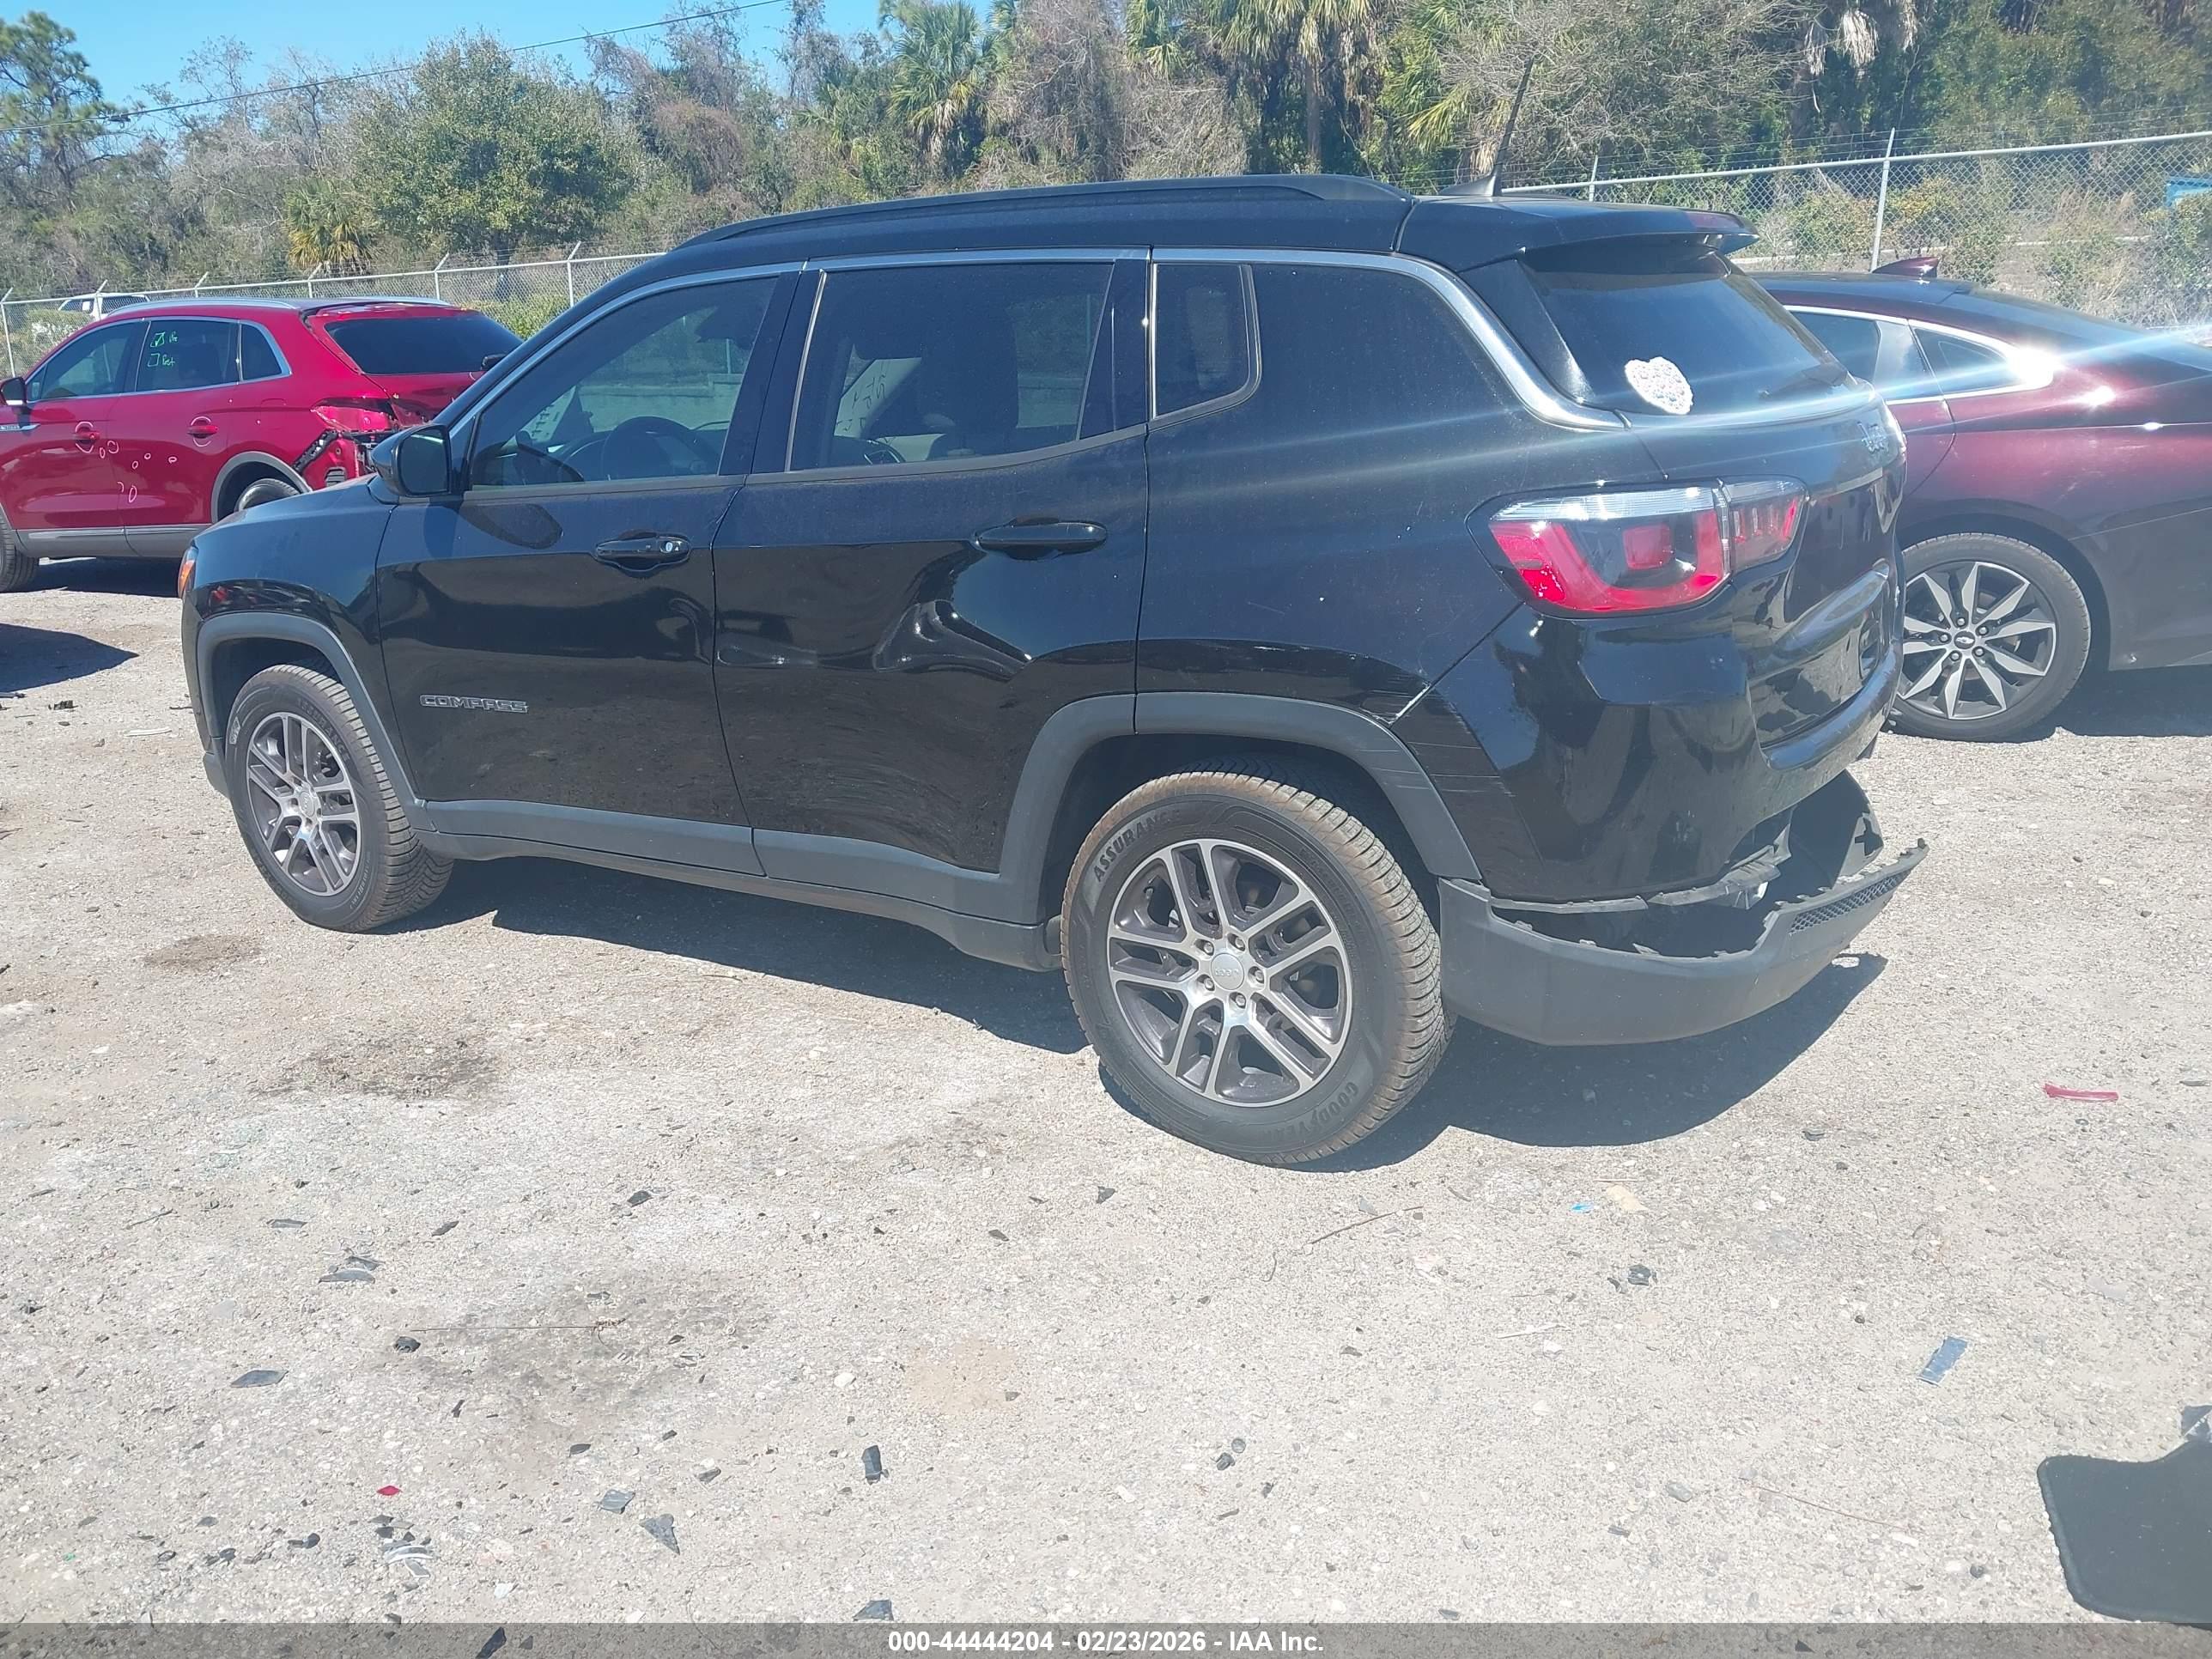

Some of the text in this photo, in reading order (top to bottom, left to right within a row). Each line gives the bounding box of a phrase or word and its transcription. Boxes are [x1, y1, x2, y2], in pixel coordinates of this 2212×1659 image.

[419, 694, 529, 714] COMPASS
[1093, 809, 1182, 883] ASSURANCE
[1264, 1081, 1359, 1140] GOODYEAR
